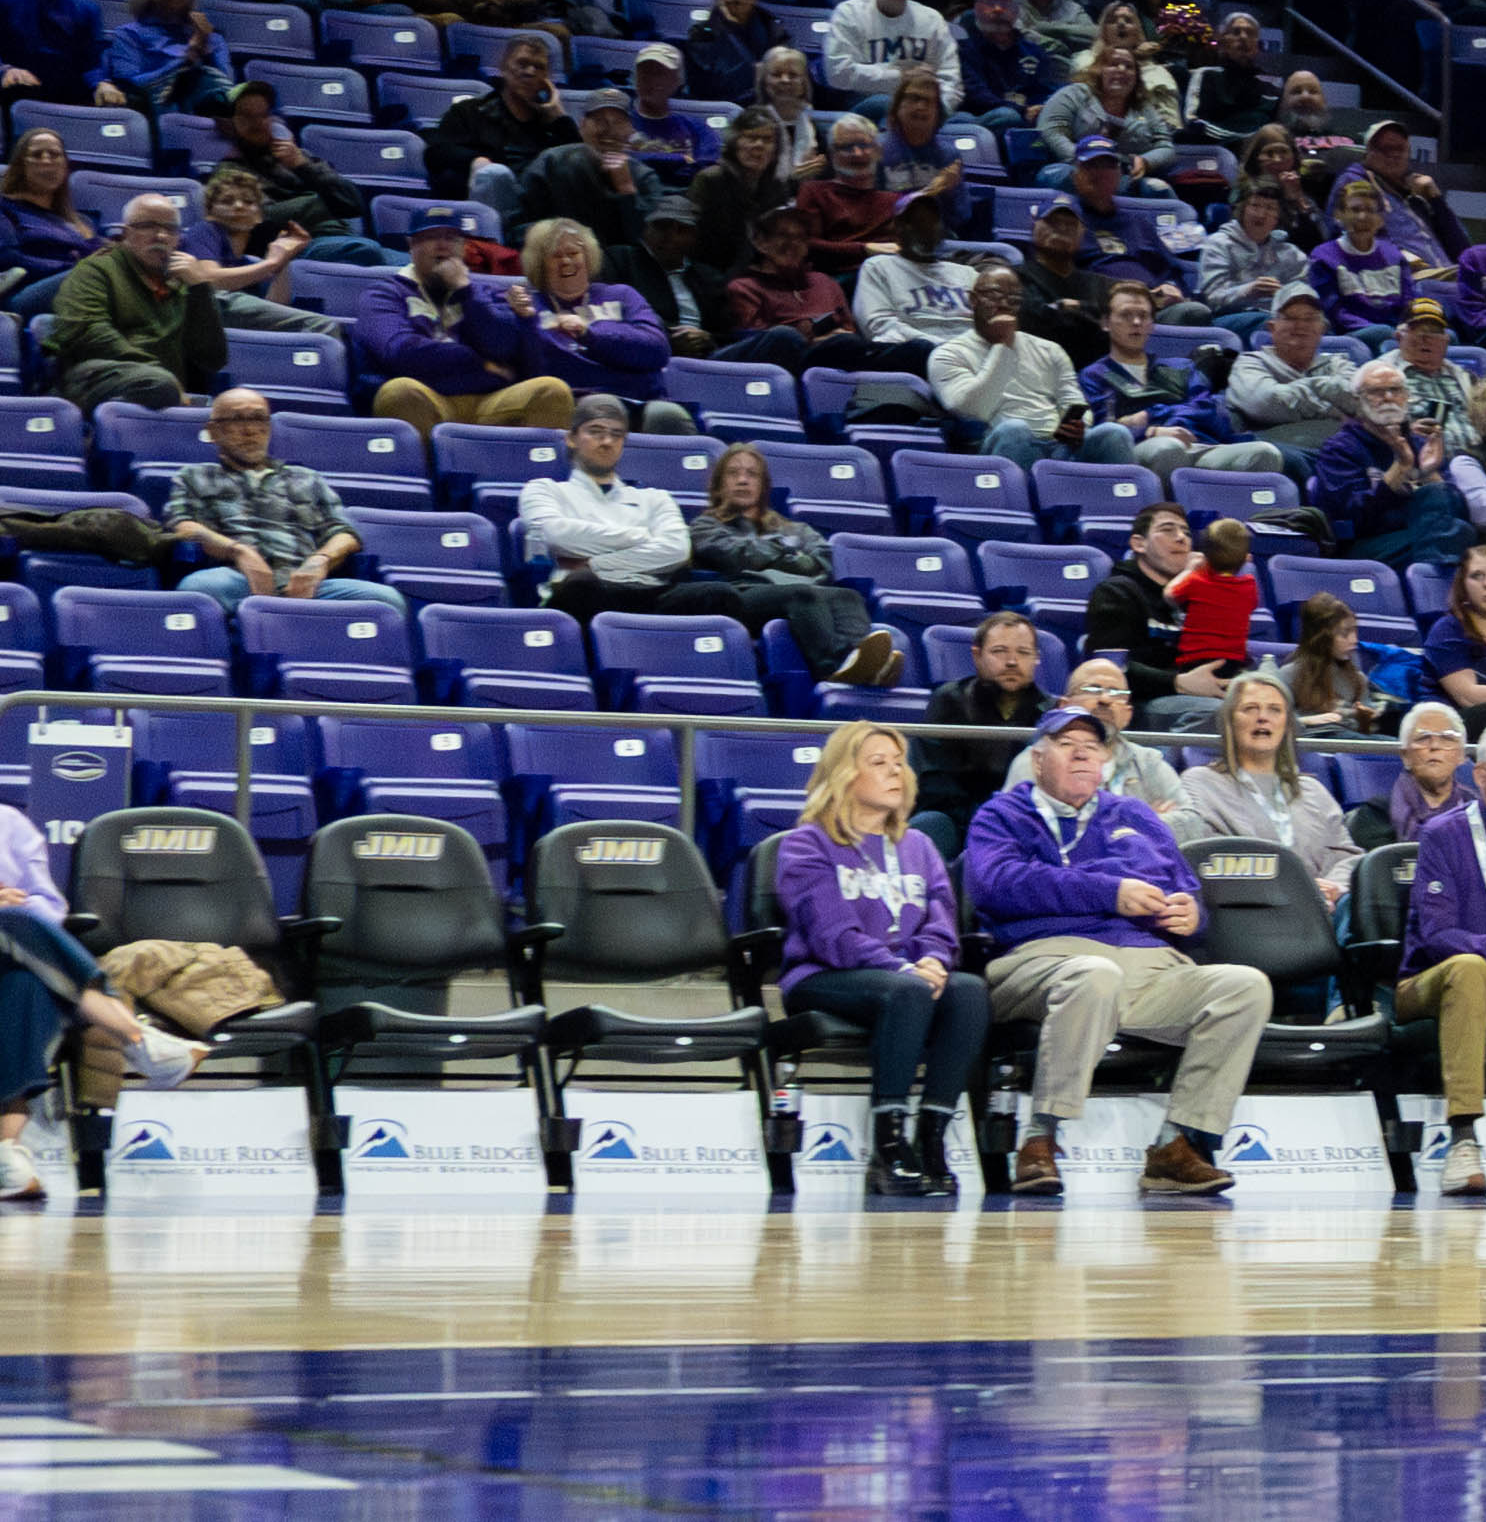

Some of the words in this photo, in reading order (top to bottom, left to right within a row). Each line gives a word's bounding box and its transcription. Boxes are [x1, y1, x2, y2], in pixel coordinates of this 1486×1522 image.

[120, 825, 218, 855] JMU
[354, 831, 447, 861] JMU
[576, 836, 669, 866] JMU
[1200, 853, 1279, 880] JMU
[178, 1145, 234, 1163] BLUE
[238, 1145, 309, 1164] RIDGE
[413, 1144, 464, 1162] BLUE
[471, 1144, 539, 1162] RIDGE
[640, 1146, 691, 1163] BLUE
[696, 1146, 761, 1164] RIDGE
[1275, 1145, 1321, 1162] BLUE
[1324, 1145, 1382, 1161] RIDGE
